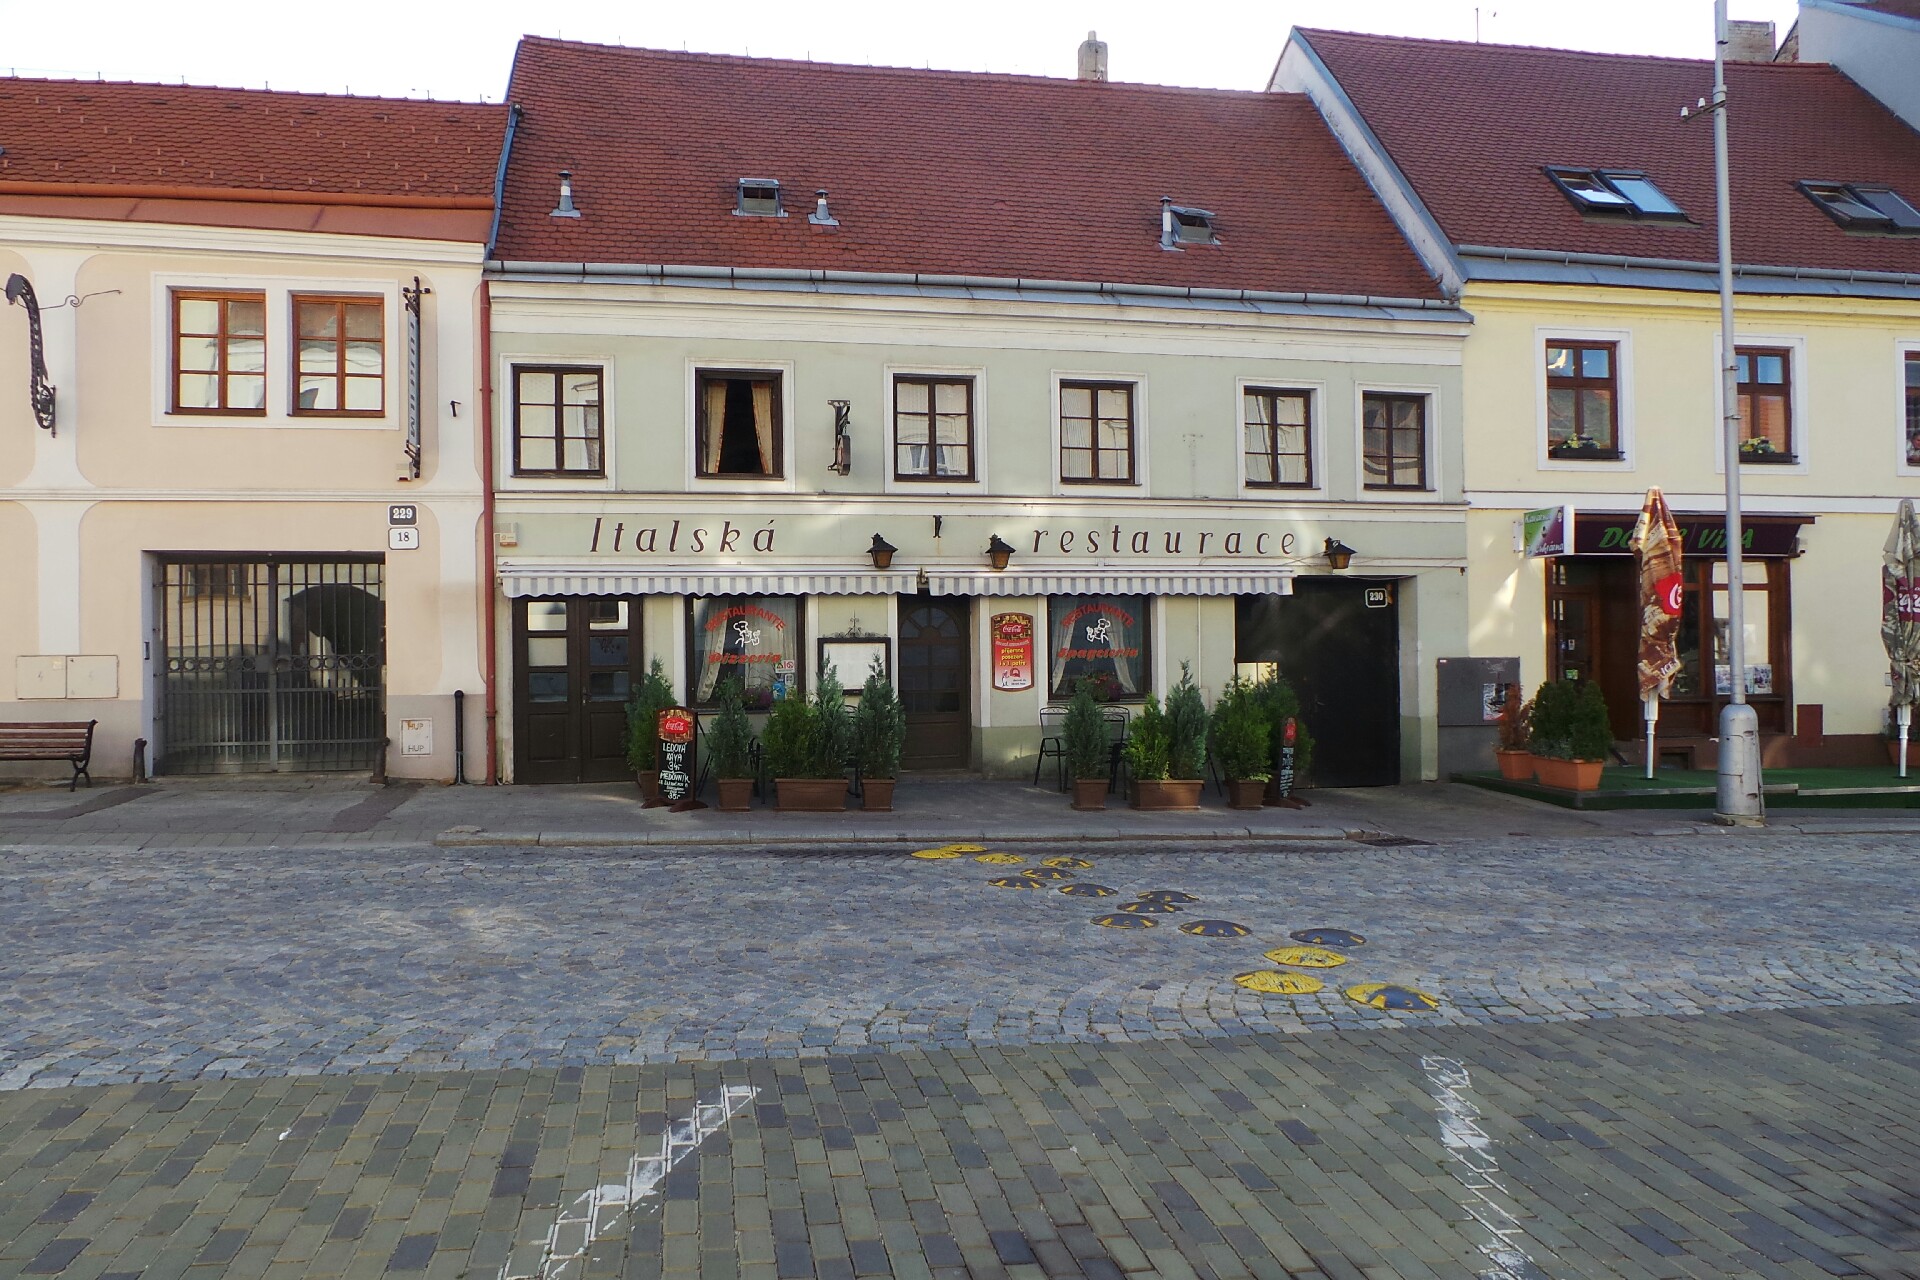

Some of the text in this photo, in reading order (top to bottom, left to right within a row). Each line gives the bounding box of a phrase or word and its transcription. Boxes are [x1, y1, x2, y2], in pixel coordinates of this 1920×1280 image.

[393, 508, 413, 519] 229
[398, 532, 410, 542] 18
[590, 517, 1295, 555] Italská restaurace
[1370, 592, 1383, 601] 230
[704, 604, 786, 632] RESTAURANTE
[408, 744, 425, 752] HUP
